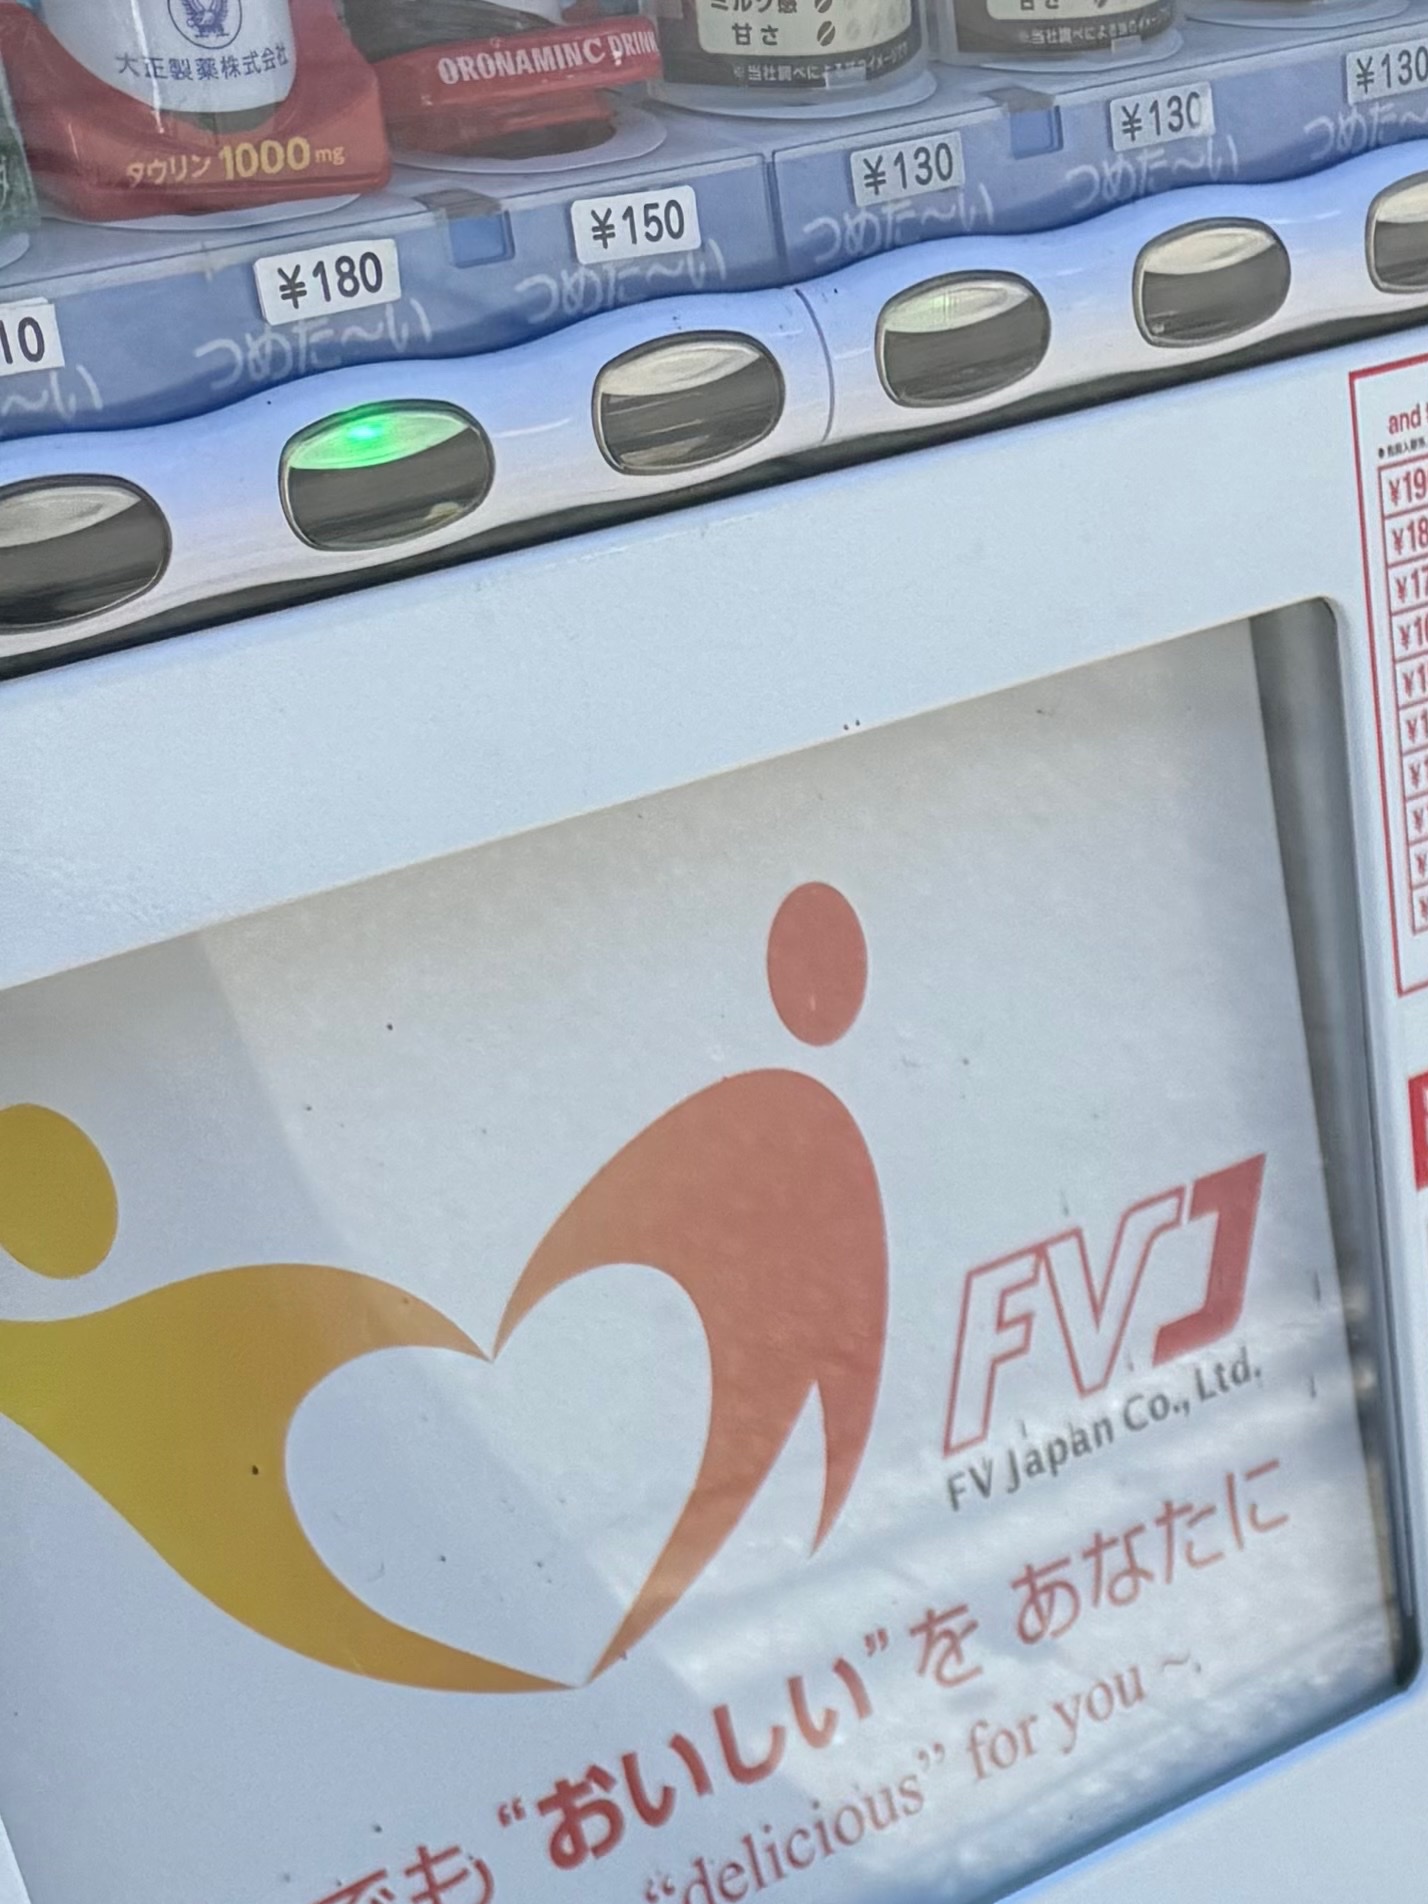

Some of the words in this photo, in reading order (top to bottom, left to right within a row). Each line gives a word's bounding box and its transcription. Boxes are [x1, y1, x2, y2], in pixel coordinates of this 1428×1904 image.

[115, 46, 289, 81] 大正製薬株式会社
[1120, 91, 1202, 142] ¥130
[126, 154, 211, 188] タウリン
[862, 142, 954, 196] ¥130
[591, 200, 687, 250] ¥150
[277, 251, 384, 309] ¥180
[1387, 405, 1422, 434] and
[945, 1456, 995, 1513] FV
[1005, 1406, 1116, 1495] Japan
[1121, 1387, 1192, 1434] Co.,
[1194, 1345, 1263, 1403] Ltd.
[962, 1714, 1039, 1781] for
[1050, 1664, 1147, 1757] you
